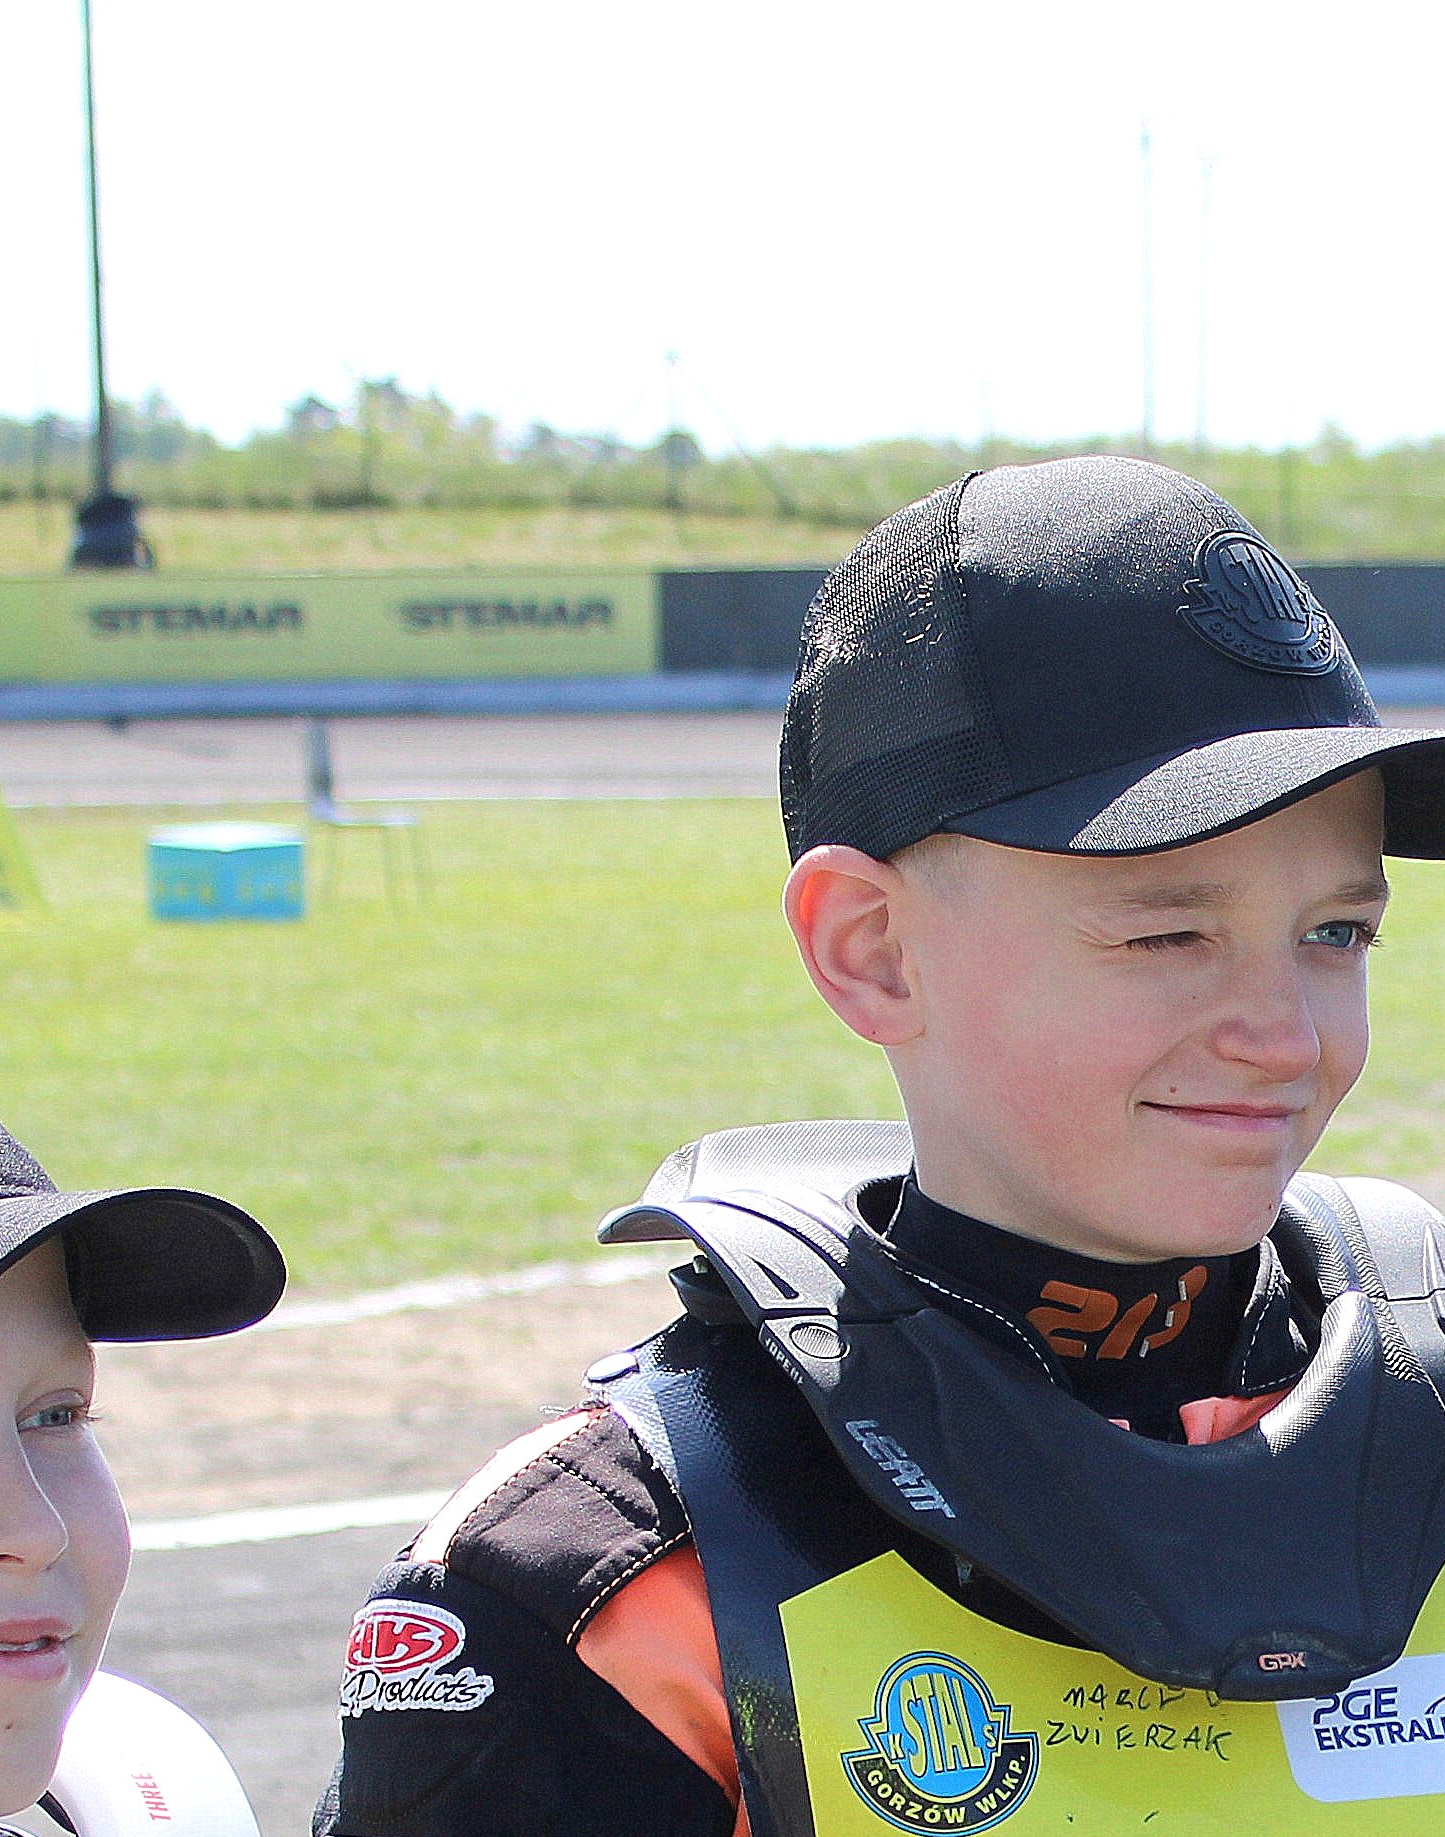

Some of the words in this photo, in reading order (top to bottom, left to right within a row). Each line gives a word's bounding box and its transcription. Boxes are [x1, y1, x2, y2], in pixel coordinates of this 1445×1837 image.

[88, 599, 303, 634] STEMAR
[397, 594, 617, 632] STEMAR
[845, 1419, 956, 1519] LEATT
[900, 1673, 985, 1778] STAL
[1313, 1686, 1398, 1725] PGE
[867, 1769, 967, 1824] GORZÓW
[976, 1754, 1028, 1815] WLKP.
